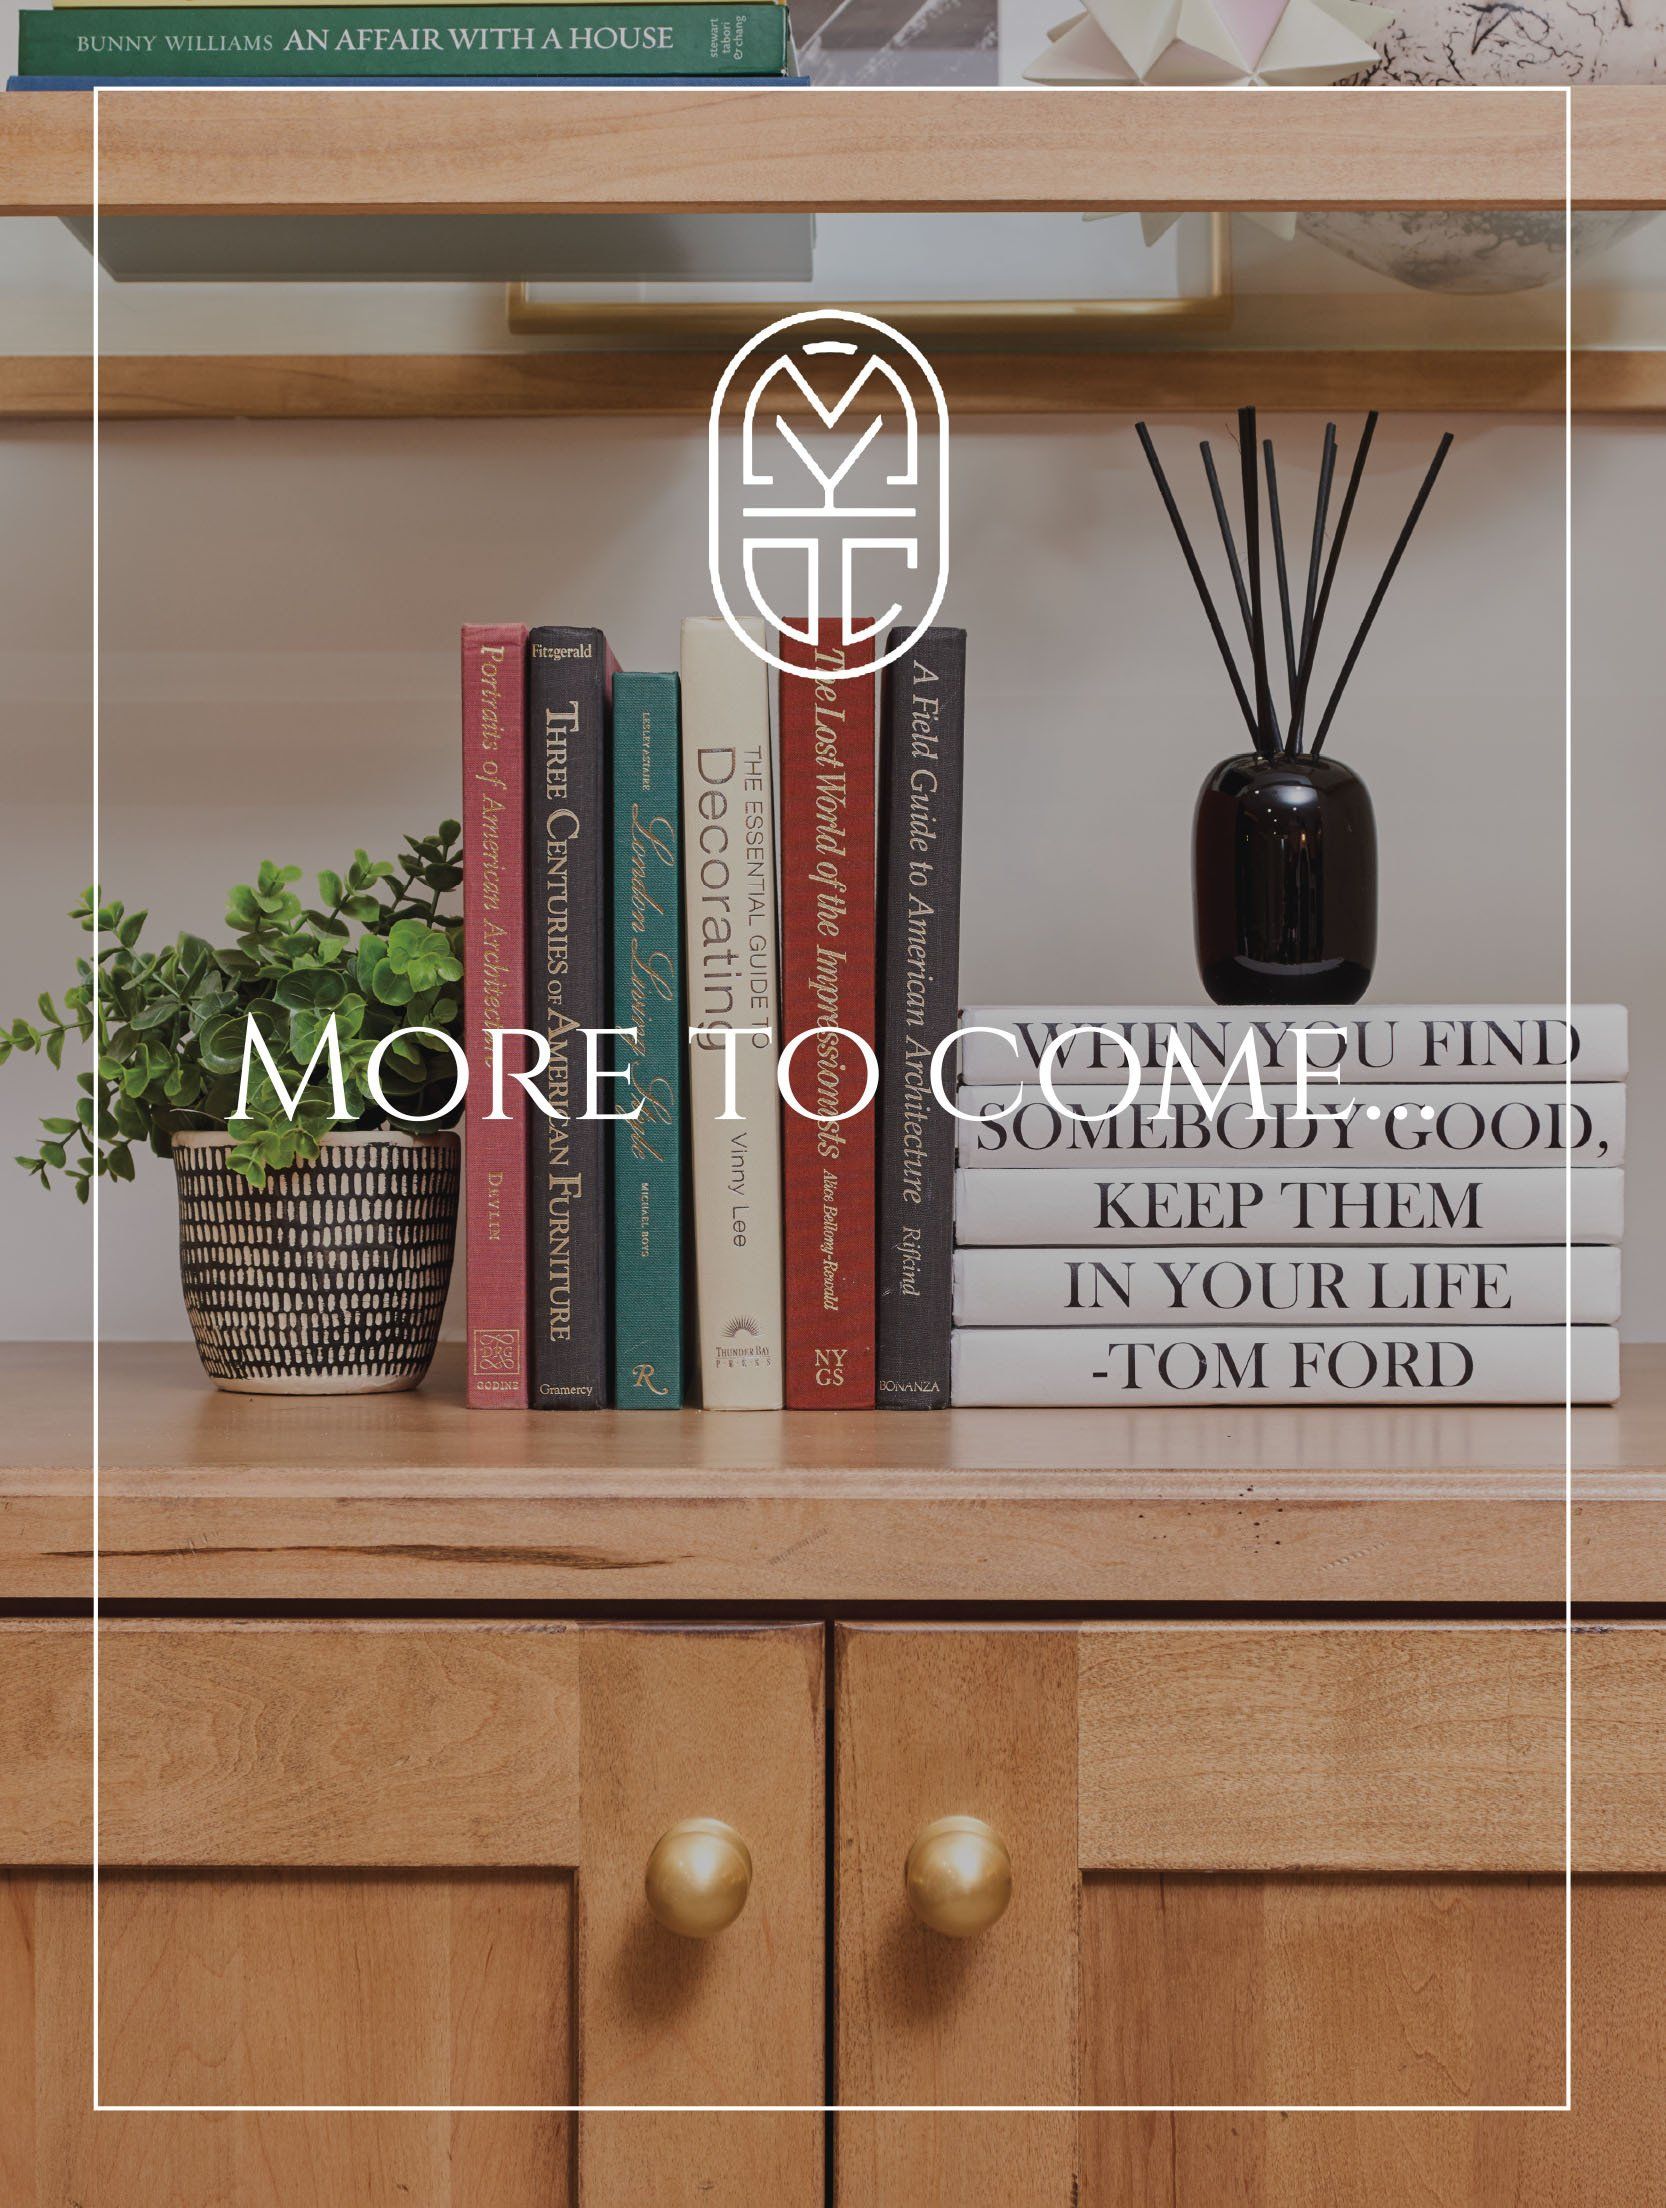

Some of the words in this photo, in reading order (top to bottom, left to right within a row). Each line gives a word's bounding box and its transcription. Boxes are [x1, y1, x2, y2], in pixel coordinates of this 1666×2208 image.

[78, 35, 157, 51] BUNNY
[165, 35, 273, 51] WILLIAMS
[283, 29, 330, 51] AN
[335, 28, 444, 51] AFFAIR
[448, 28, 536, 50] WITH
[541, 28, 563, 50] A
[569, 27, 674, 50] HOUSE
[710, 17, 719, 58] stewart
[720, 21, 731, 53] tabori
[732, 15, 747, 47] chang
[531, 643, 593, 661] Fitzgerald
[912, 659, 940, 685] A
[480, 645, 505, 750] Portraits
[546, 700, 580, 801] THREE
[641, 711, 651, 747] LESLEY
[814, 702, 846, 768] Lost
[911, 694, 940, 760] Field
[475, 759, 508, 790] of
[641, 749, 651, 792] ASTAIRE
[743, 745, 763, 792] THE
[814, 771, 847, 857] World
[908, 768, 939, 853] Guide
[482, 793, 508, 911] American
[631, 802, 675, 933] London
[745, 800, 766, 926] ESSENTIAL
[908, 858, 935, 886] to
[546, 808, 580, 976] CENTURIES
[696, 747, 743, 1051] Decorating
[808, 860, 847, 893] of
[816, 890, 848, 937] the
[749, 935, 769, 1009] GUIDE
[906, 892, 935, 1027] American
[547, 979, 562, 1005] OF
[614, 937, 675, 1057] Living
[750, 1016, 770, 1049] TO
[808, 944, 848, 1160] Impressionists
[1012, 1021, 1232, 1069] WHEN
[1249, 1020, 1400, 1068] YOU
[1419, 1019, 1581, 1067] FIND
[547, 1008, 581, 1167] AMERICAN
[614, 1059, 676, 1162] Style
[903, 1034, 933, 1205] Architecture
[977, 1102, 1367, 1150] SOMEBODY
[1384, 1102, 1609, 1159] GOOD,
[728, 1131, 748, 1196] Vinny
[823, 1168, 838, 1202] Alice
[488, 1171, 504, 1240] DEVLIN
[640, 1182, 650, 1228] MICHAEL
[732, 1205, 749, 1248] Lee
[1093, 1182, 1264, 1229] KEEP
[1280, 1182, 1485, 1229] THEM
[548, 1171, 582, 1342] FURNITURE
[640, 1231, 650, 1257] BOYS
[899, 1226, 921, 1296] Rifkind
[1063, 1262, 1133, 1309] IN
[1153, 1262, 1350, 1310] YOUR
[1368, 1263, 1512, 1309] LIFE
[715, 1346, 754, 1357] THUNDER
[814, 1349, 848, 1367] NY
[1092, 1342, 1270, 1390] -TOM
[1290, 1340, 1475, 1389] FORD
[476, 1381, 519, 1391] GODINE
[539, 1383, 593, 1397] Gramercy
[632, 1363, 669, 1395] R
[815, 1368, 845, 1386] GS
[879, 1380, 940, 1392] BONANZA
